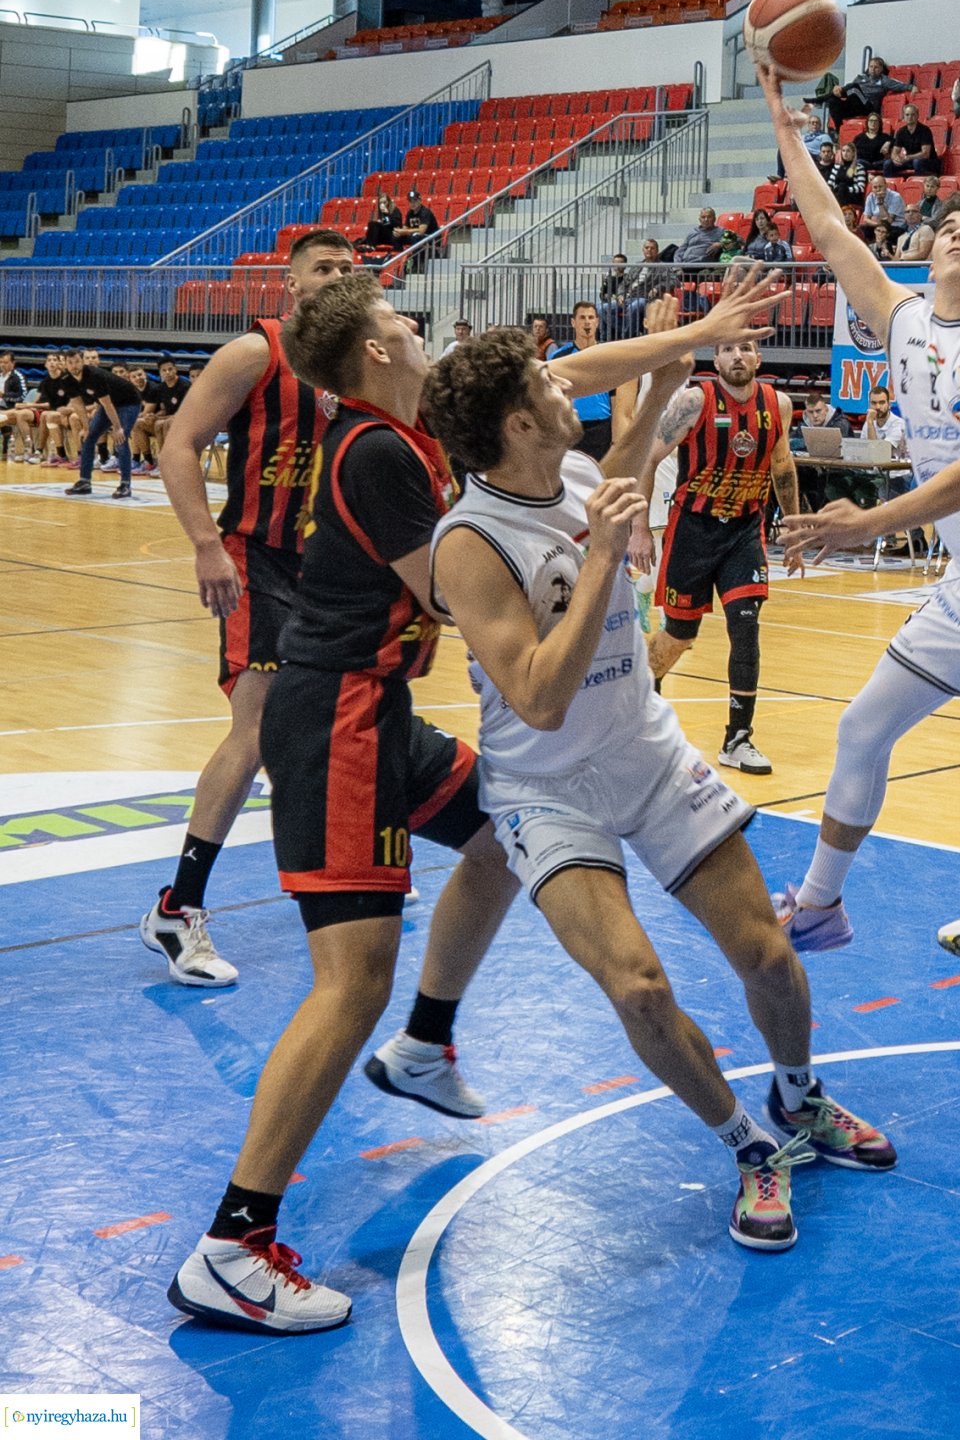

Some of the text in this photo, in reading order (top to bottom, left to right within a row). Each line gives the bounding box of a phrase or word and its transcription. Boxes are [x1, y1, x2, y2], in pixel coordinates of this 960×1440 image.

[755, 411, 772, 430] 13
[541, 545, 565, 563] JAKO
[665, 586, 677, 606] 13
[379, 826, 409, 867] 10
